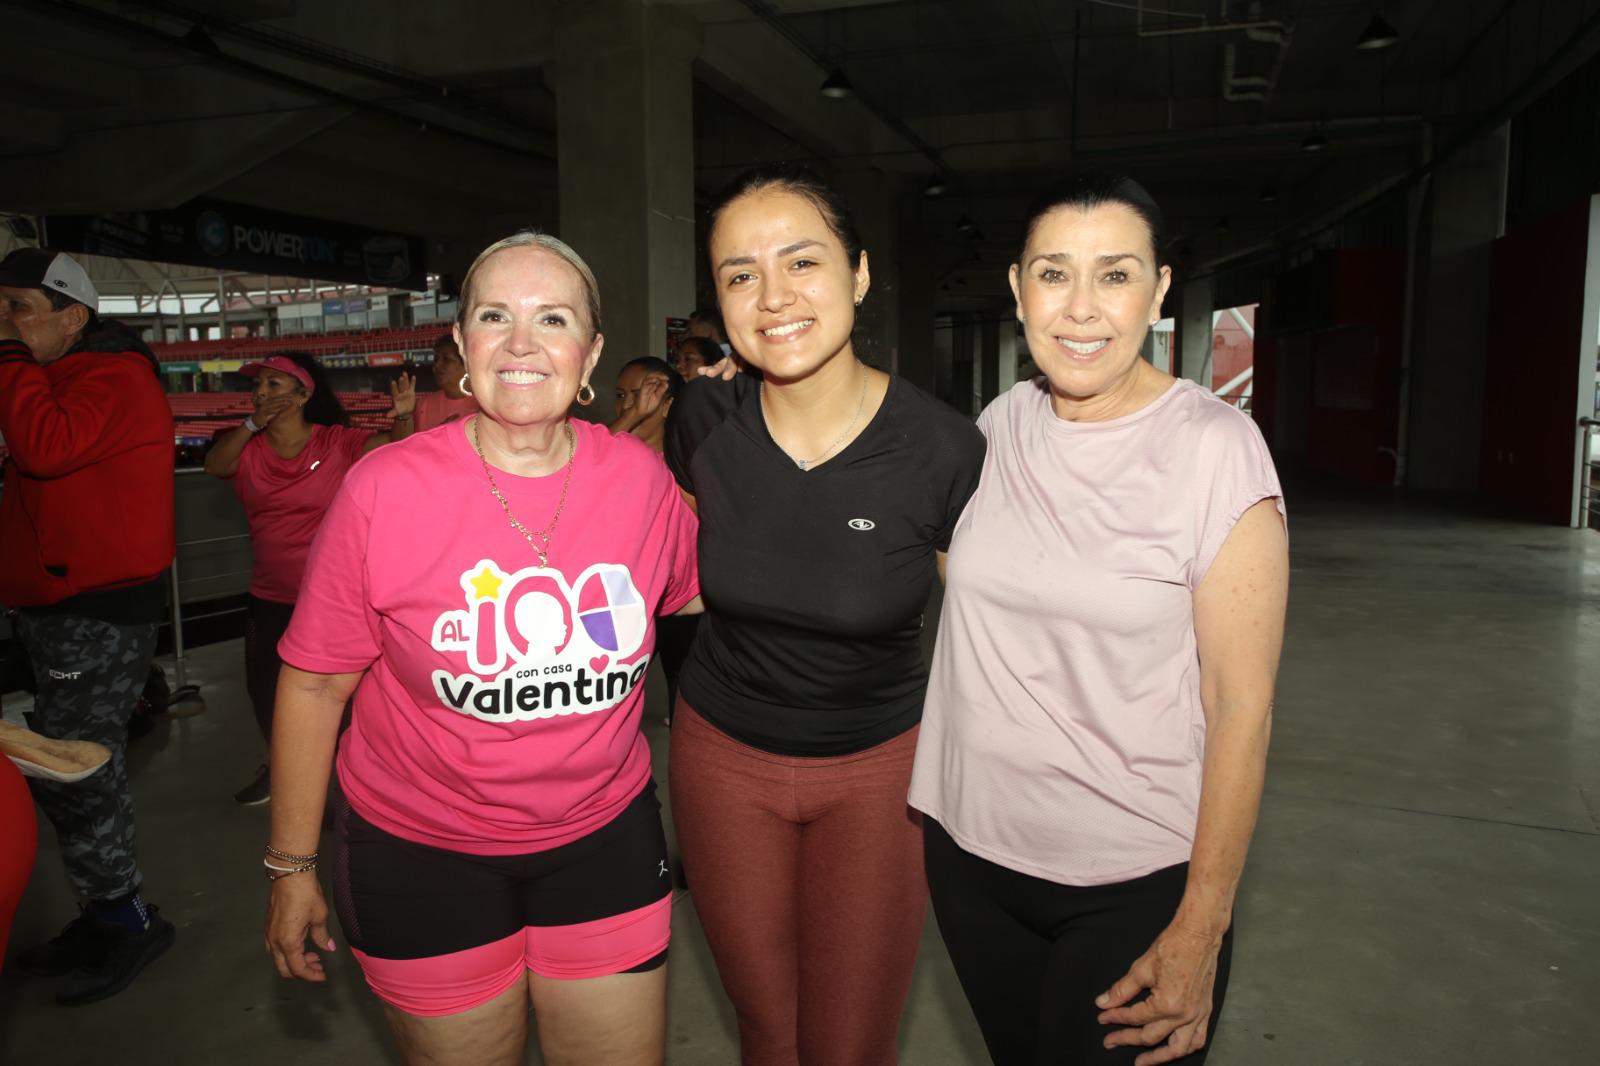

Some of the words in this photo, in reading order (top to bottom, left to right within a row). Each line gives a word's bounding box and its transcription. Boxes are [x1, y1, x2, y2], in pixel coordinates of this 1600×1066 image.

[441, 620, 470, 642] AL
[516, 669, 538, 679] con
[544, 664, 572, 675] casa
[440, 662, 647, 715] Valentina
